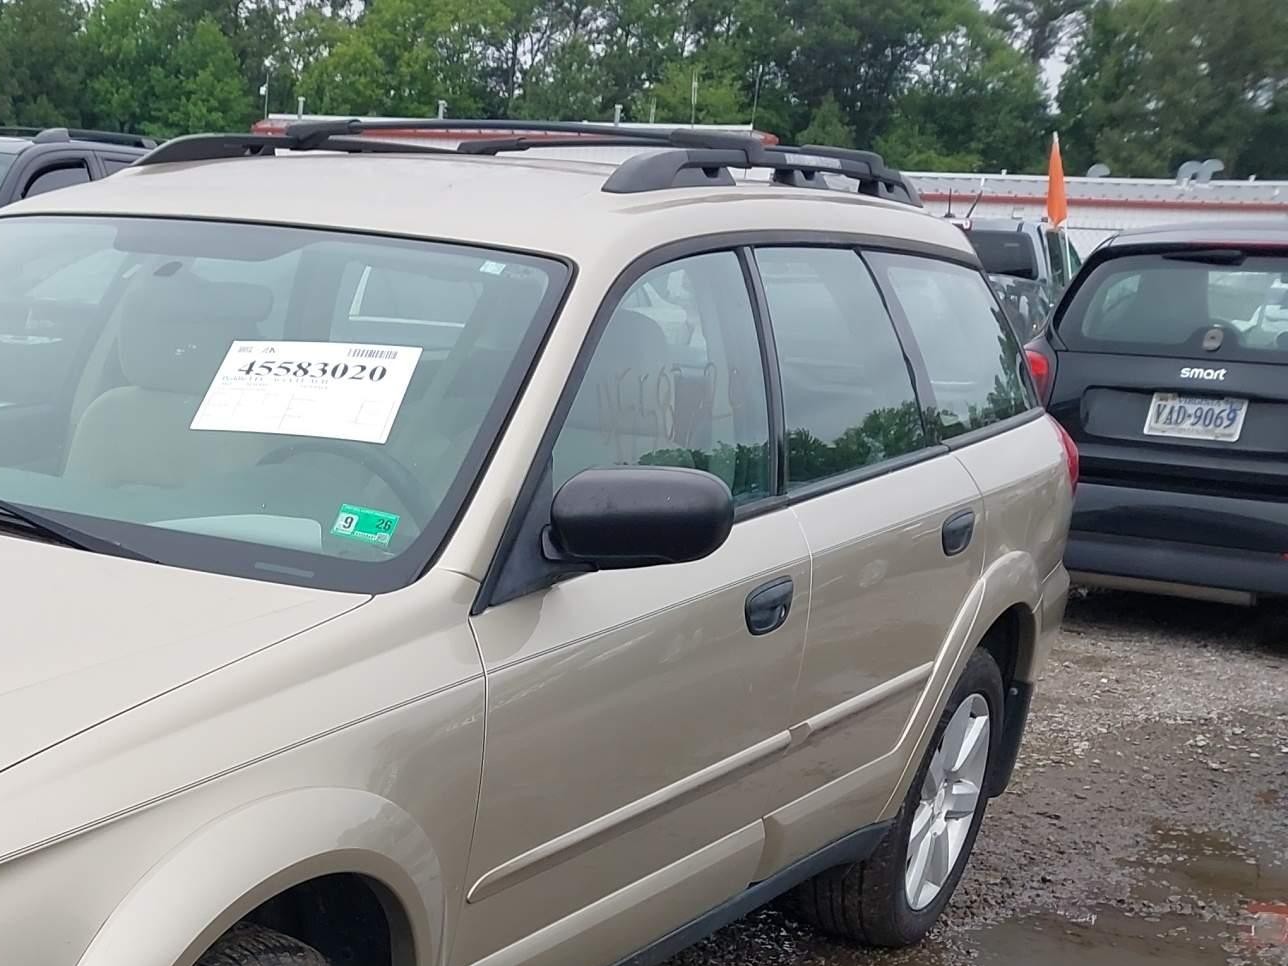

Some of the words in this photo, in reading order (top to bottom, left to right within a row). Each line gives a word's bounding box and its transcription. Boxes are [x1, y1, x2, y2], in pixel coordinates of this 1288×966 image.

[238, 361, 387, 382] 45583020
[1180, 367, 1227, 380] smart
[343, 516, 354, 529] 9
[376, 518, 393, 531] 26
